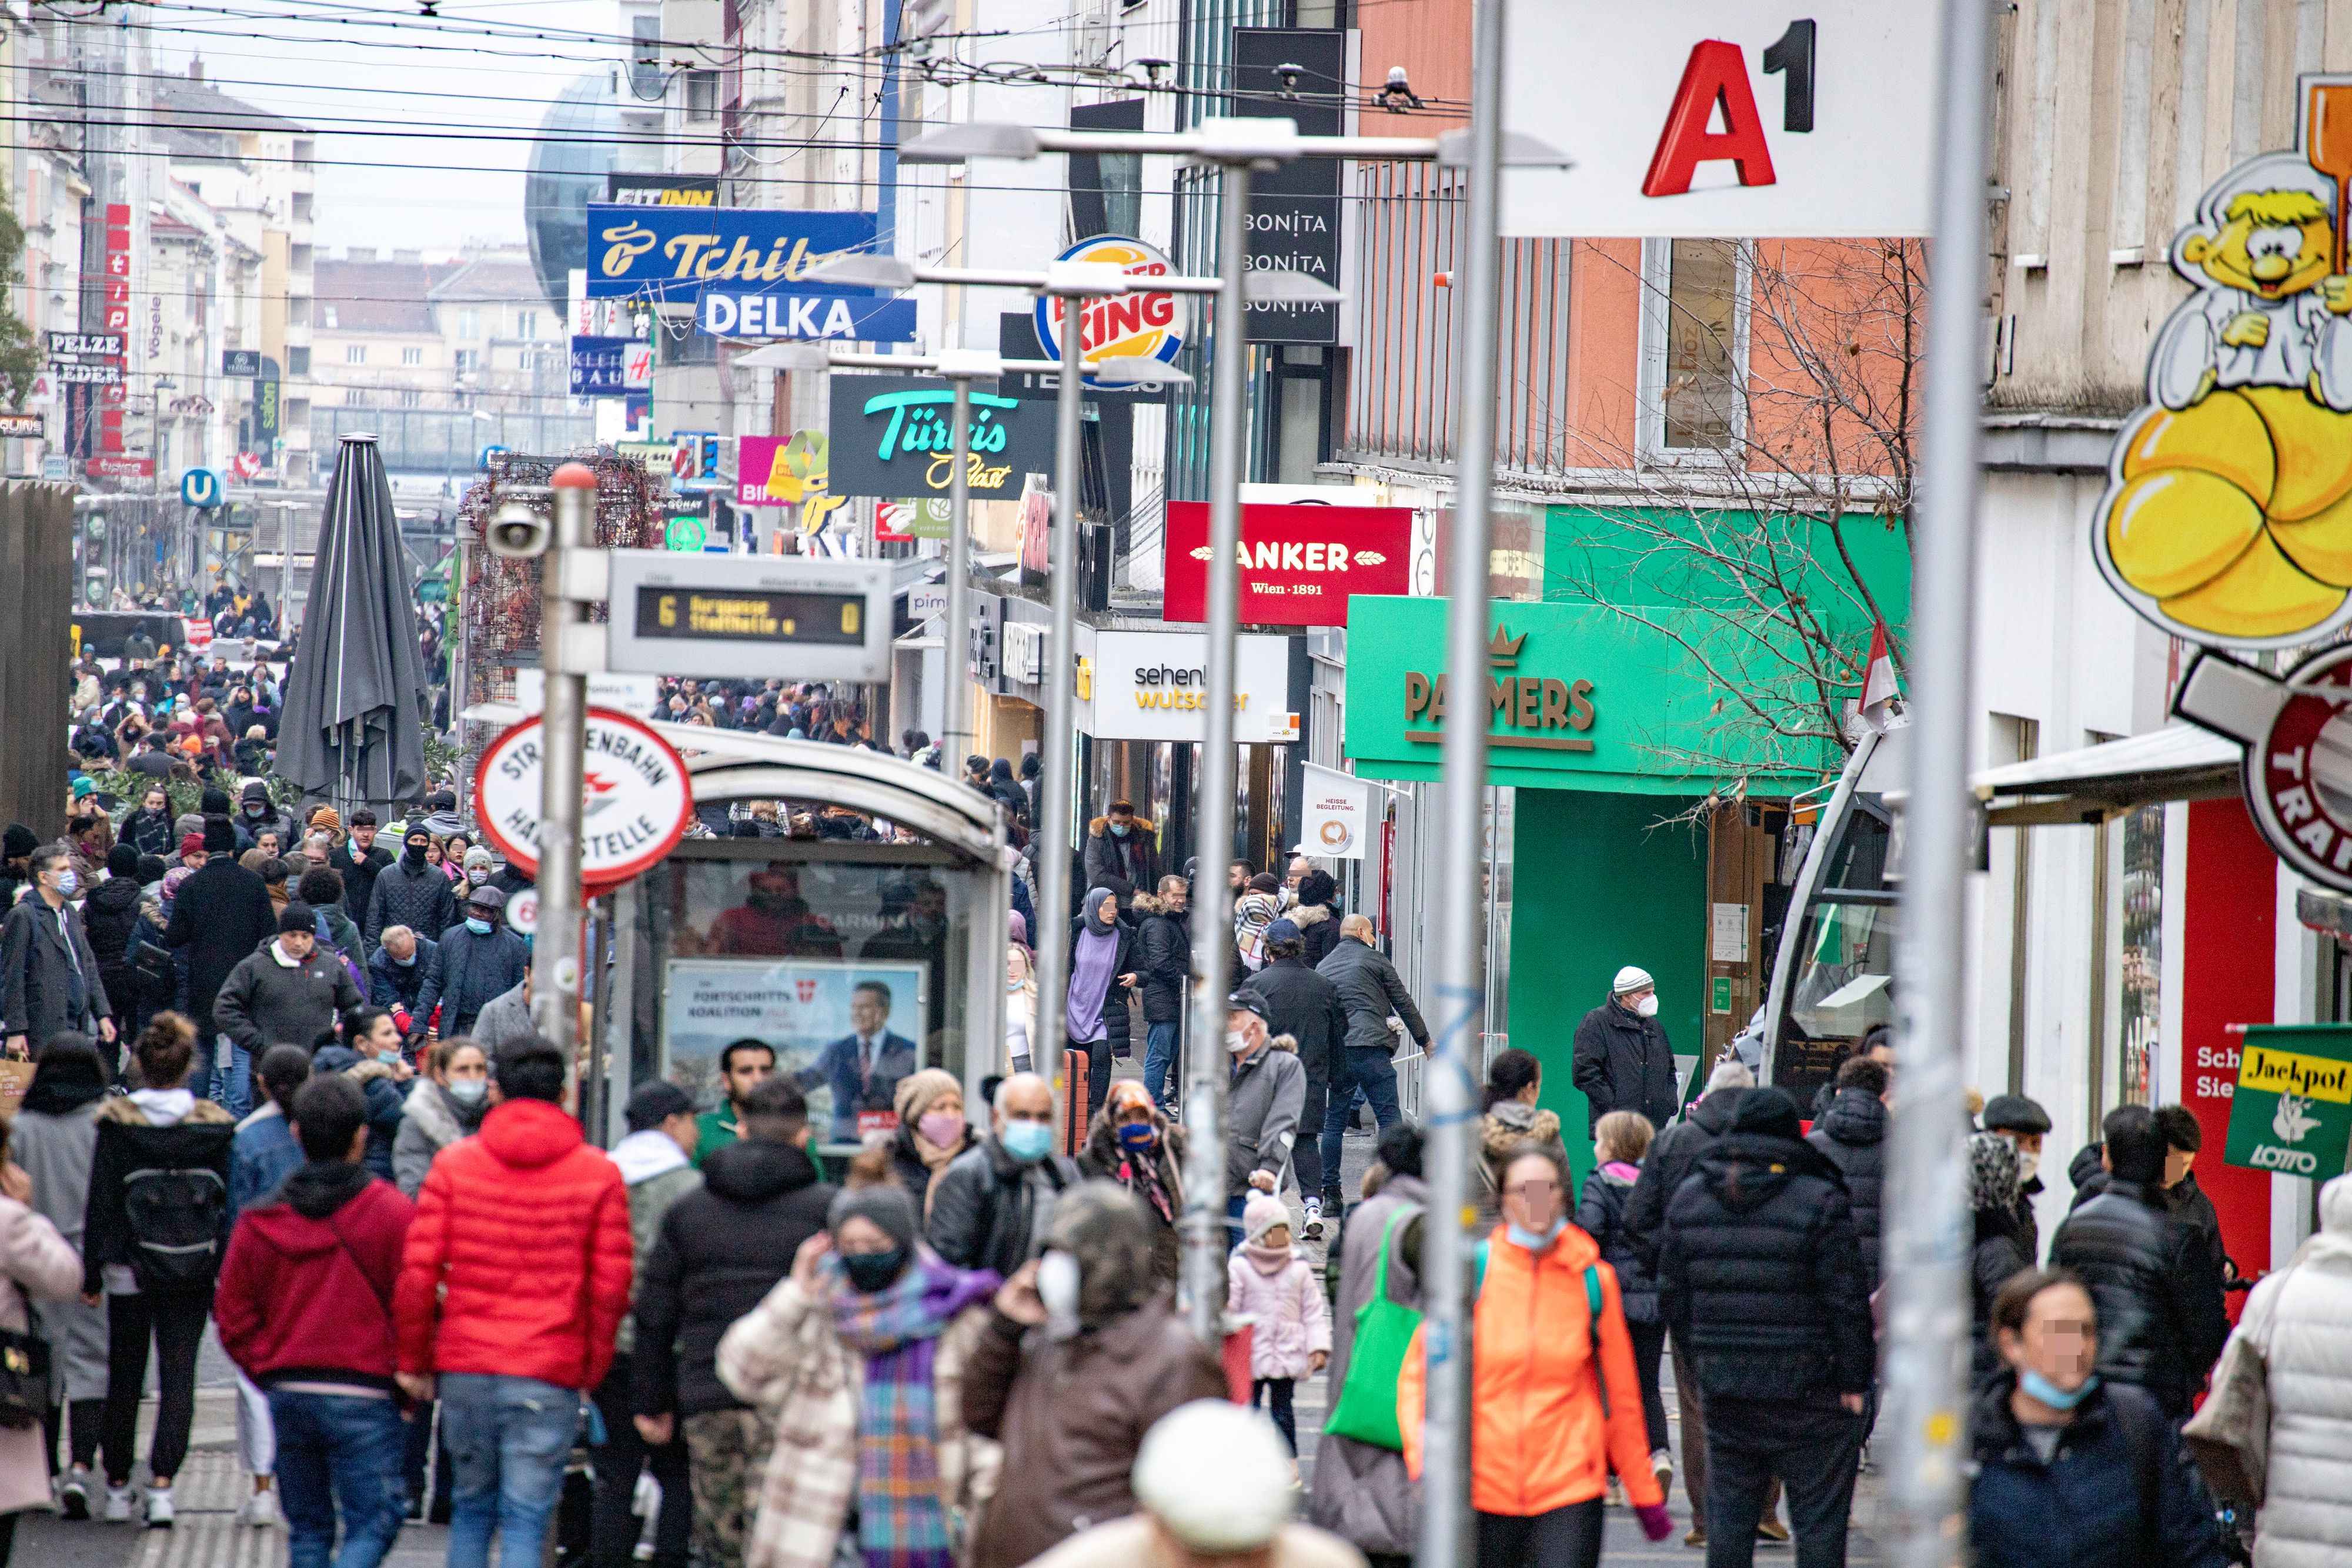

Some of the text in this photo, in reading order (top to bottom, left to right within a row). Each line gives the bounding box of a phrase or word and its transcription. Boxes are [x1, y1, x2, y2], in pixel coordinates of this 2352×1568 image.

[1642, 18, 1816, 197] A1
[664, 234, 866, 282] Tchib
[706, 293, 856, 338] DELKA
[1060, 292, 1174, 352] KING
[50, 333, 120, 353] PELZE
[629, 351, 654, 380] H&
[187, 474, 212, 503] U
[1236, 540, 1349, 571] ANKER
[914, 592, 946, 611] pim
[1251, 582, 1322, 595] Wien 1891
[1135, 663, 1207, 686] sehen!
[1135, 687, 1249, 711] wutscer
[1404, 671, 1595, 731] PAMERS
[501, 728, 670, 788] STRENBAHN
[2197, 1046, 2241, 1069] Sch
[2196, 1075, 2234, 1098] Sie
[2247, 1052, 2348, 1094] Jackpot
[2249, 1144, 2317, 1174] LOTTO
